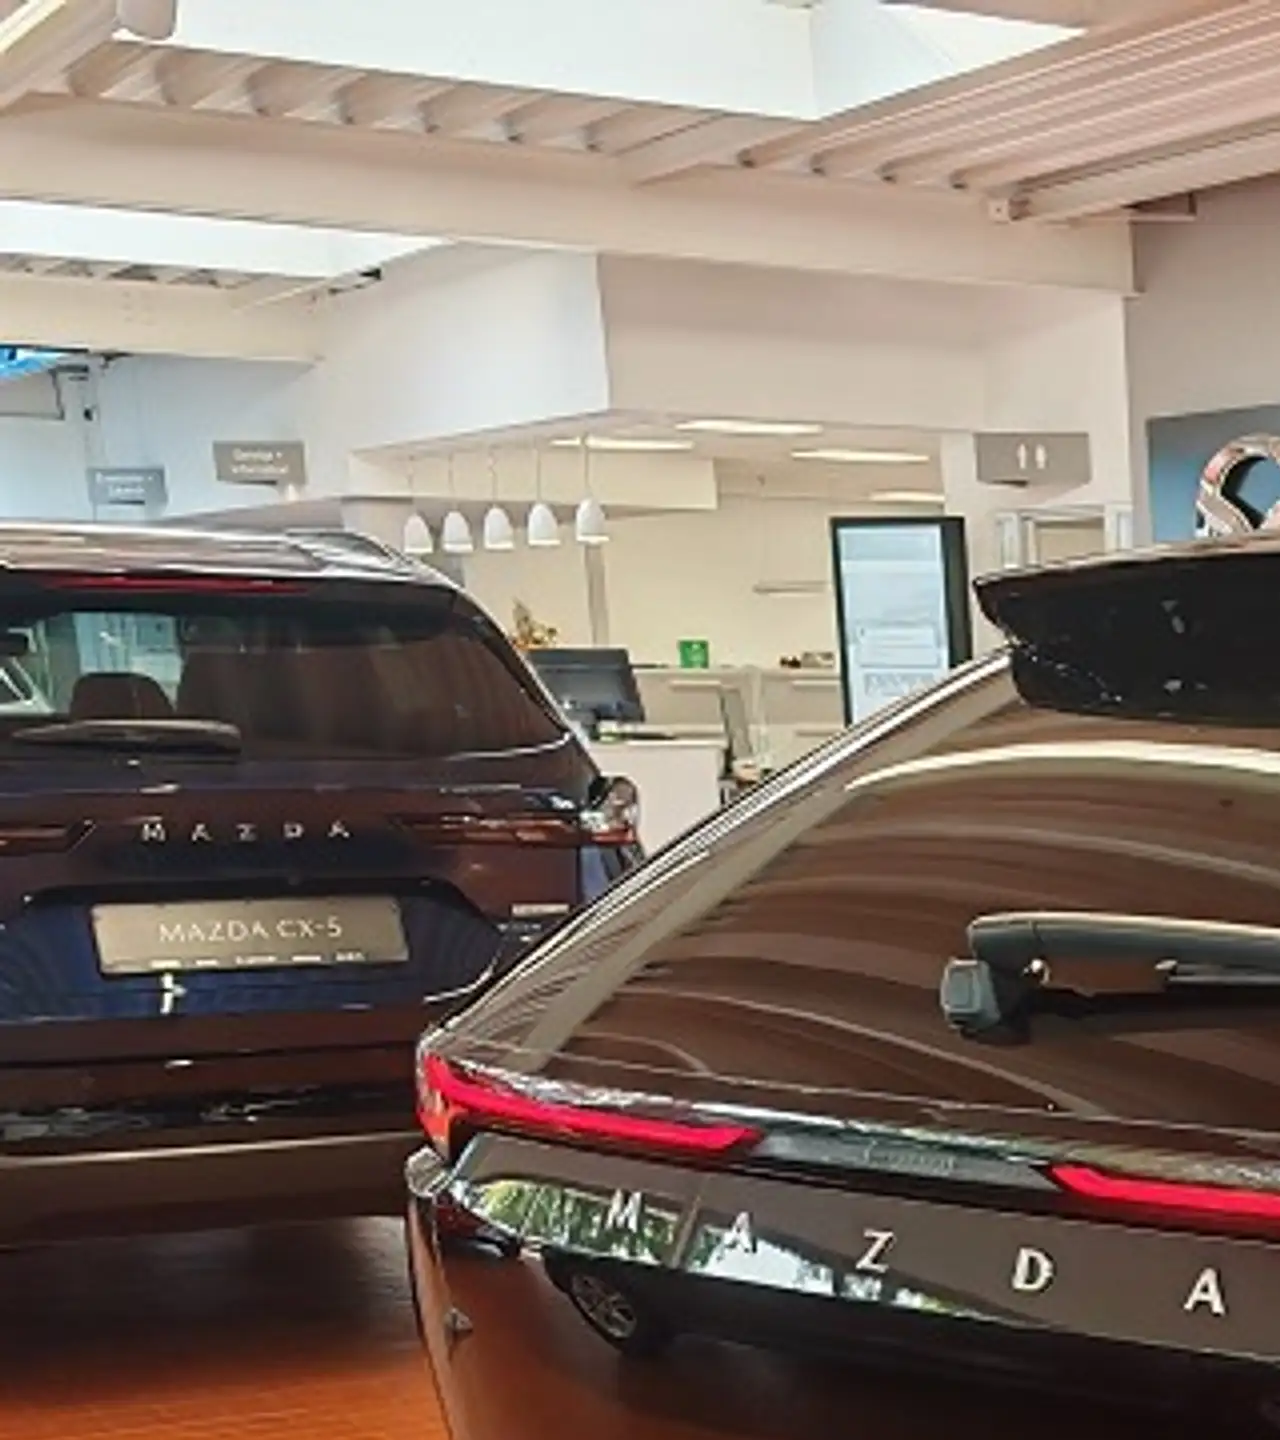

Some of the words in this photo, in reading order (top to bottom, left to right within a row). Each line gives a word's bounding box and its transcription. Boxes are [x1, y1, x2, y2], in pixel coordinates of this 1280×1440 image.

[143, 821, 350, 842] MAZDA
[159, 920, 269, 943] MAZDA
[276, 915, 343, 938] CX-5
[605, 1187, 1227, 1317] MAZDA
